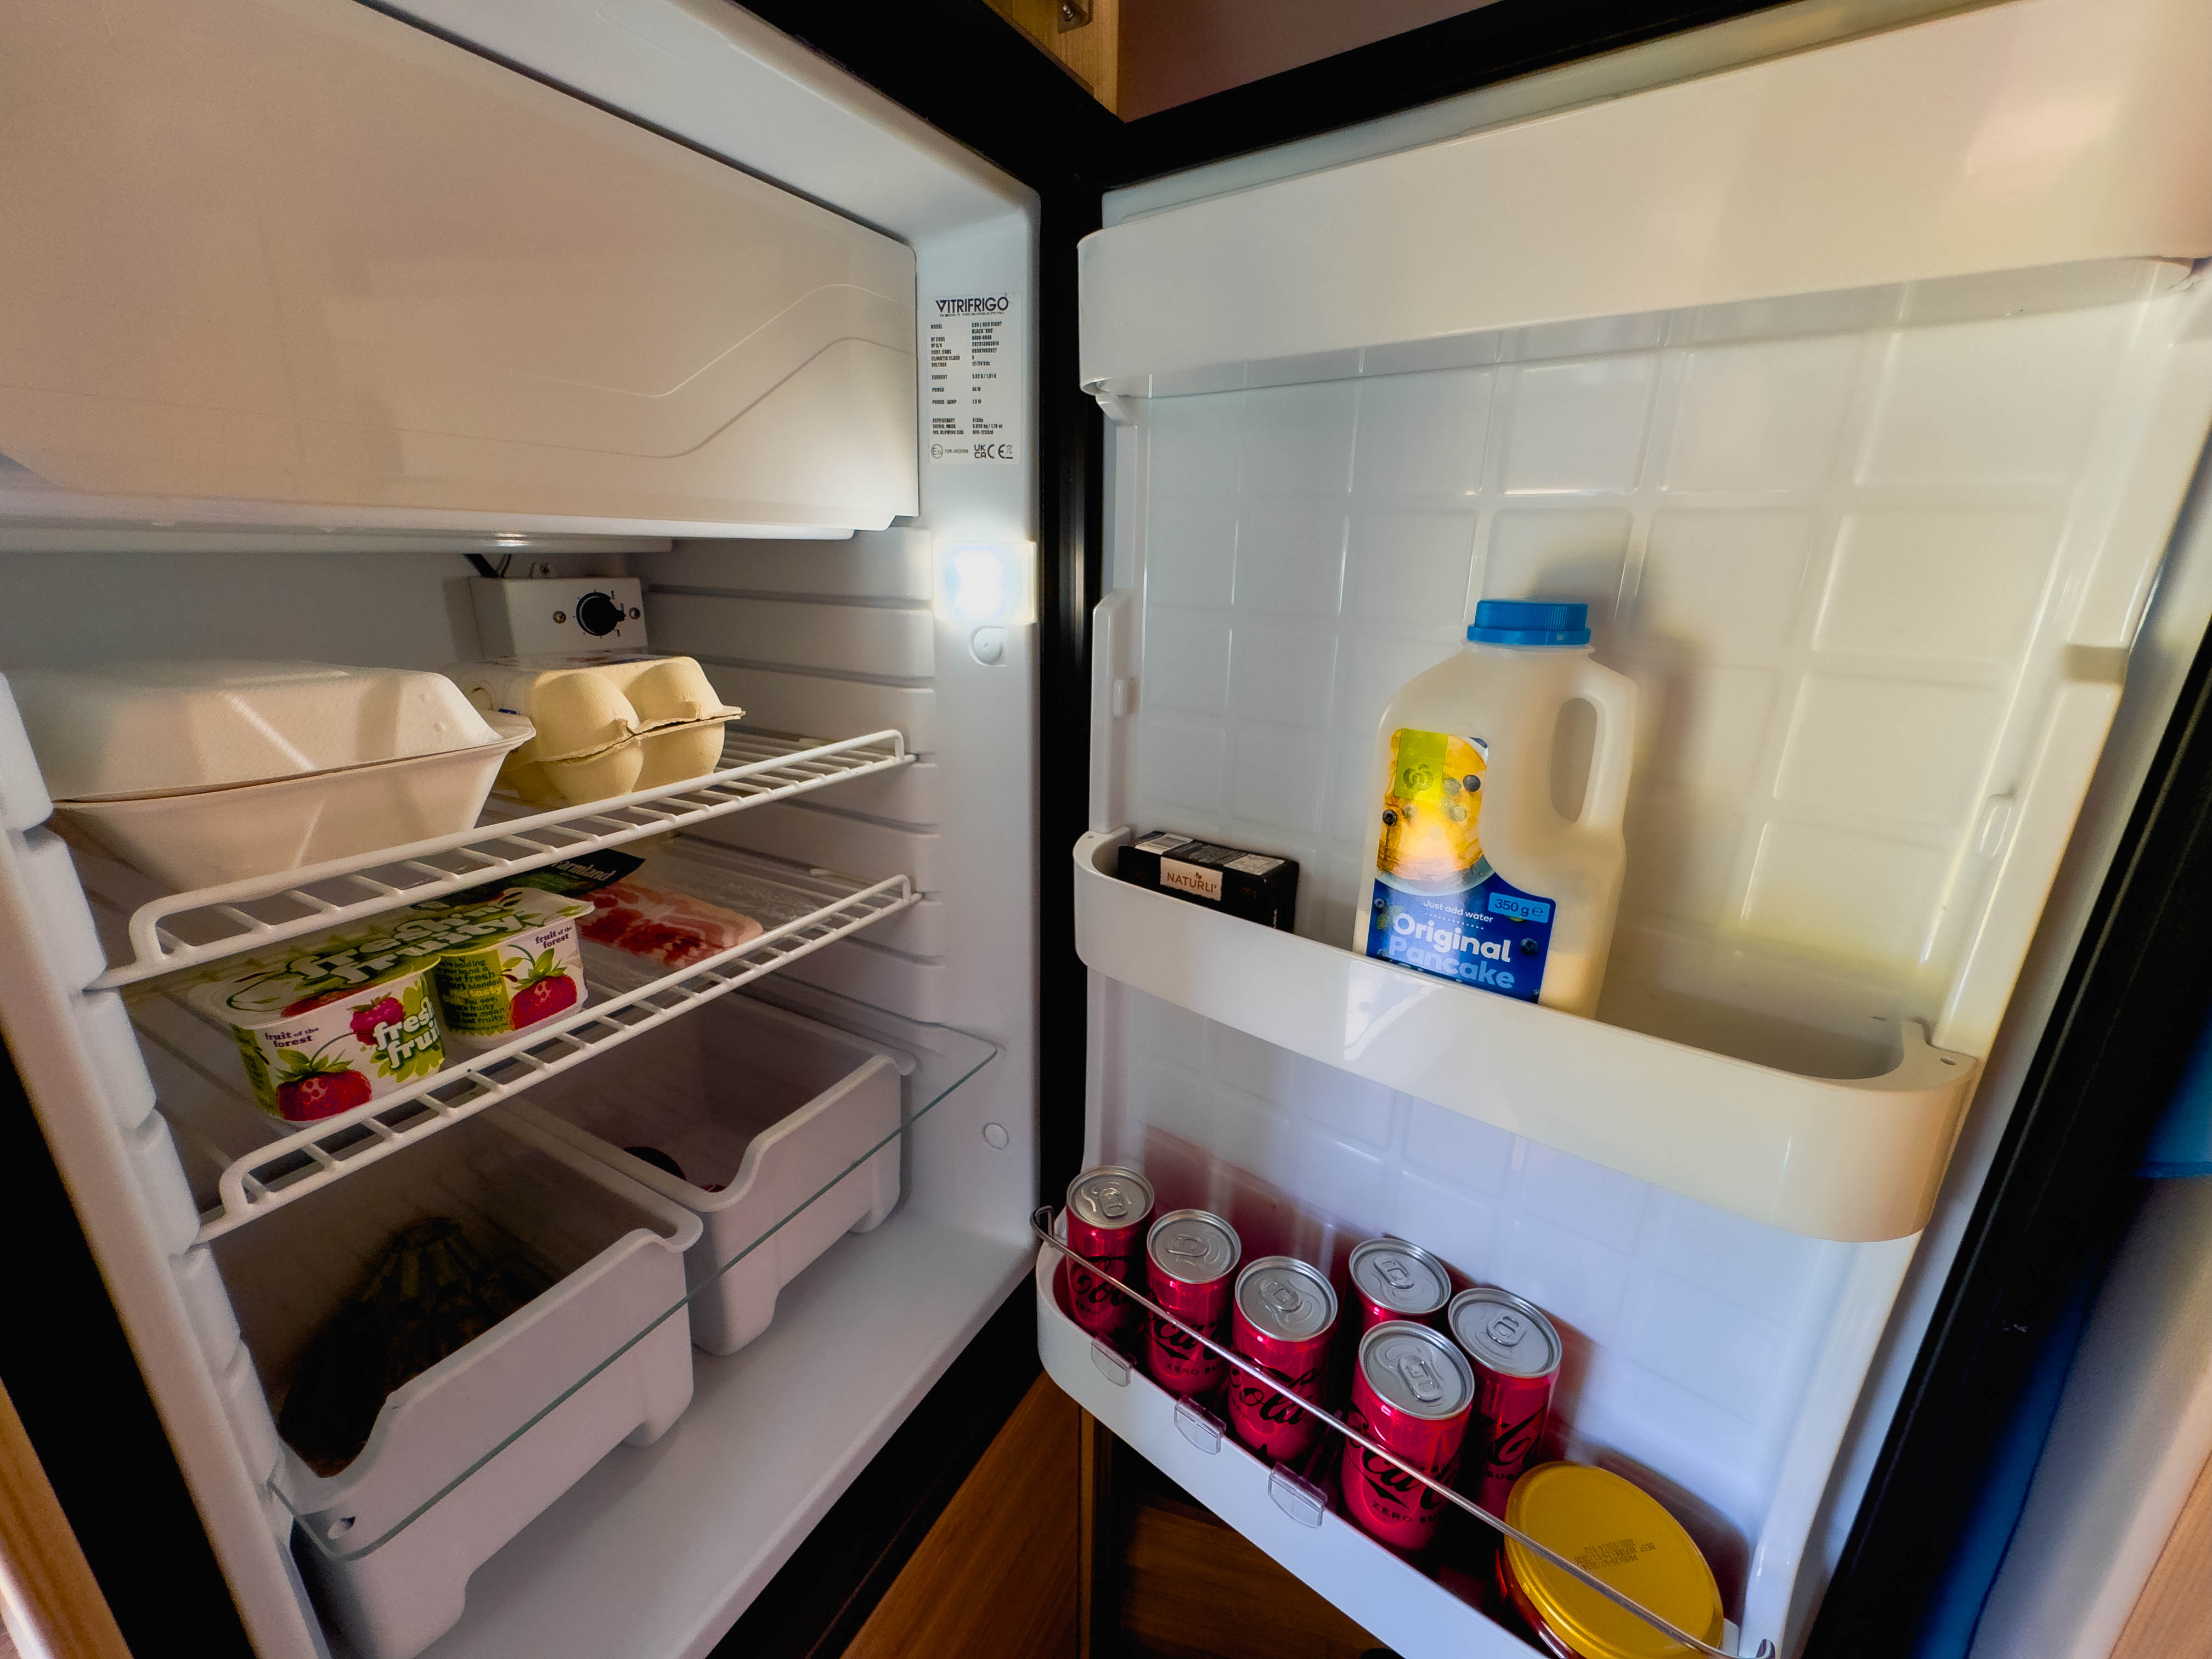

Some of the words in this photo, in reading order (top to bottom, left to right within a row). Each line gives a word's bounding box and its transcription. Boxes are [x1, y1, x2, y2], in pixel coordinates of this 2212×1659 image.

[935, 296, 1009, 313] VITRIFRIGO
[1422, 899, 1443, 911] Just
[1445, 906, 1464, 916] add
[1465, 911, 1494, 923] water
[1494, 899, 1519, 912] 350
[1521, 906, 1530, 917] g
[535, 931, 557, 944] fruit
[543, 934, 569, 948] forest
[1392, 912, 1511, 963] Original
[455, 960, 487, 968] holding
[1388, 935, 1515, 989] Pancake
[459, 967, 480, 975] hand
[464, 970, 496, 983] fresh
[469, 977, 503, 990] blended
[469, 986, 503, 997] tasty
[470, 1003, 495, 1013] fruity
[481, 1007, 505, 1017] mean
[477, 1014, 506, 1024] fruity.
[264, 1031, 292, 1041] fruit
[304, 1026, 320, 1035] the
[273, 1035, 313, 1048] forest
[1372, 1499, 1412, 1523] ZERO
